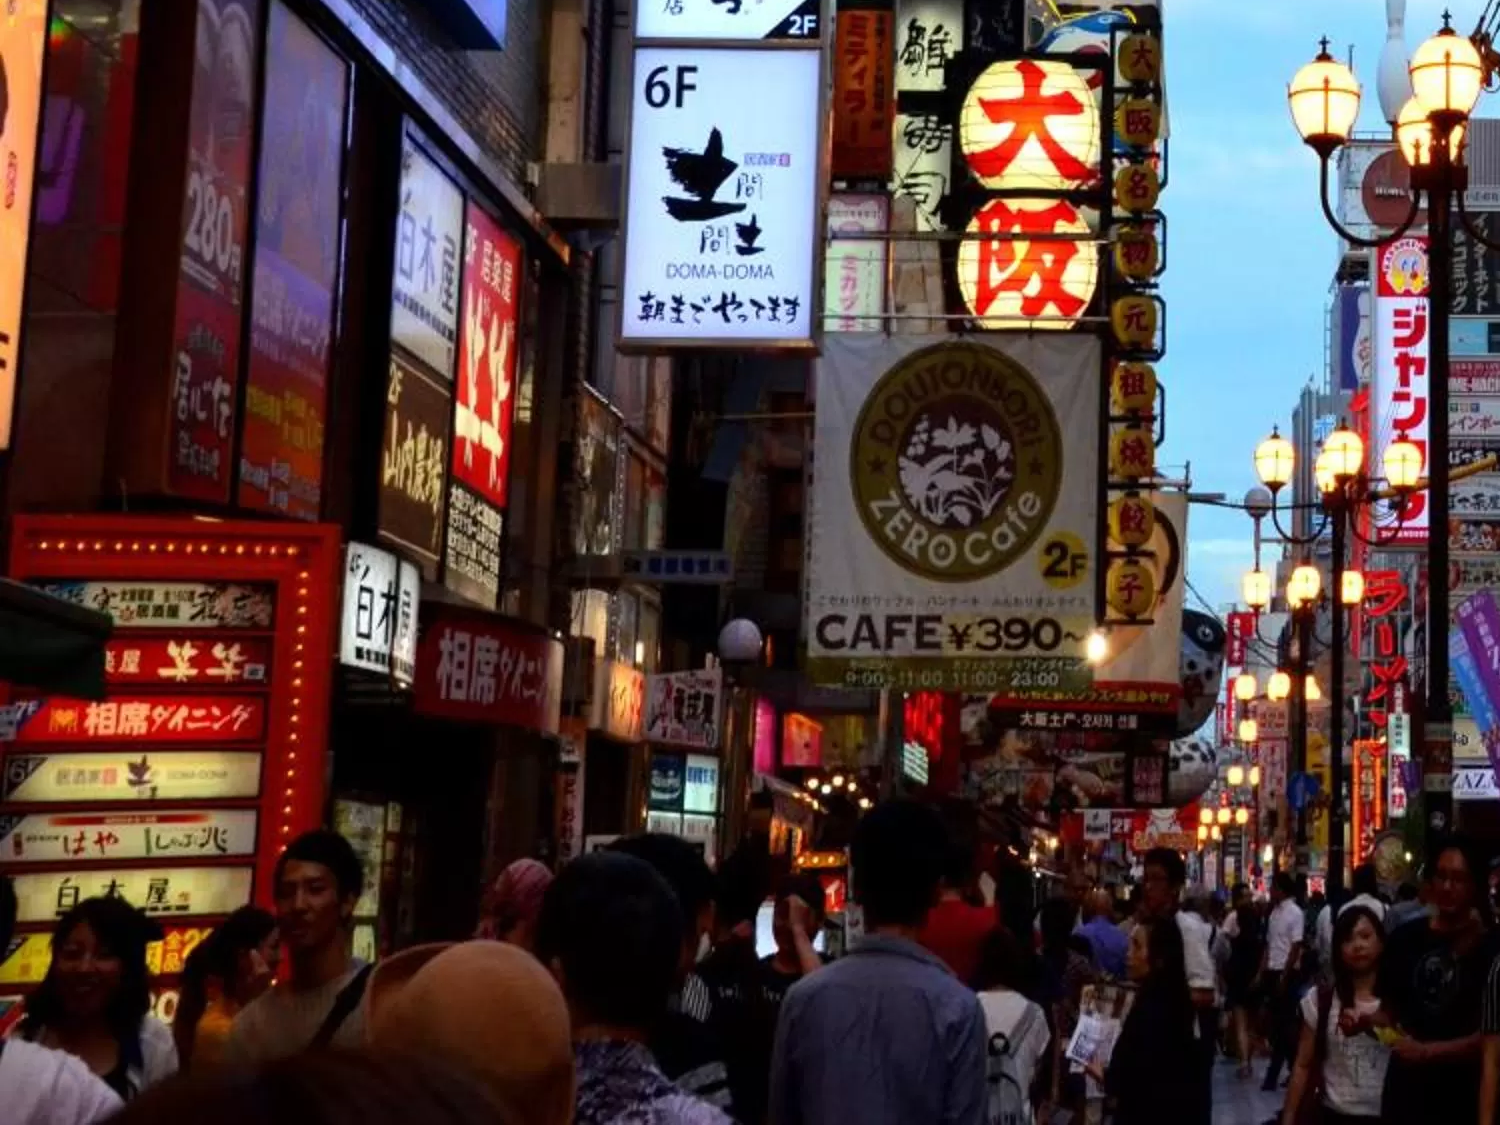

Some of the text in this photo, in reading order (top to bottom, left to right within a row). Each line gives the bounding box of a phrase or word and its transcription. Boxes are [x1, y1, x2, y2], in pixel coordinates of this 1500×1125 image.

[788, 15, 817, 35] 2F
[645, 65, 698, 109] 6F
[960, 58, 1101, 317] 大阪
[665, 262, 774, 280] DOMA-DOMA
[868, 489, 957, 569] ZERO
[1042, 540, 1088, 580] 2F
[815, 614, 942, 650] CAFE
[157, 639, 246, 683] 笑笑
[83, 700, 255, 737] 相席ダイニング
